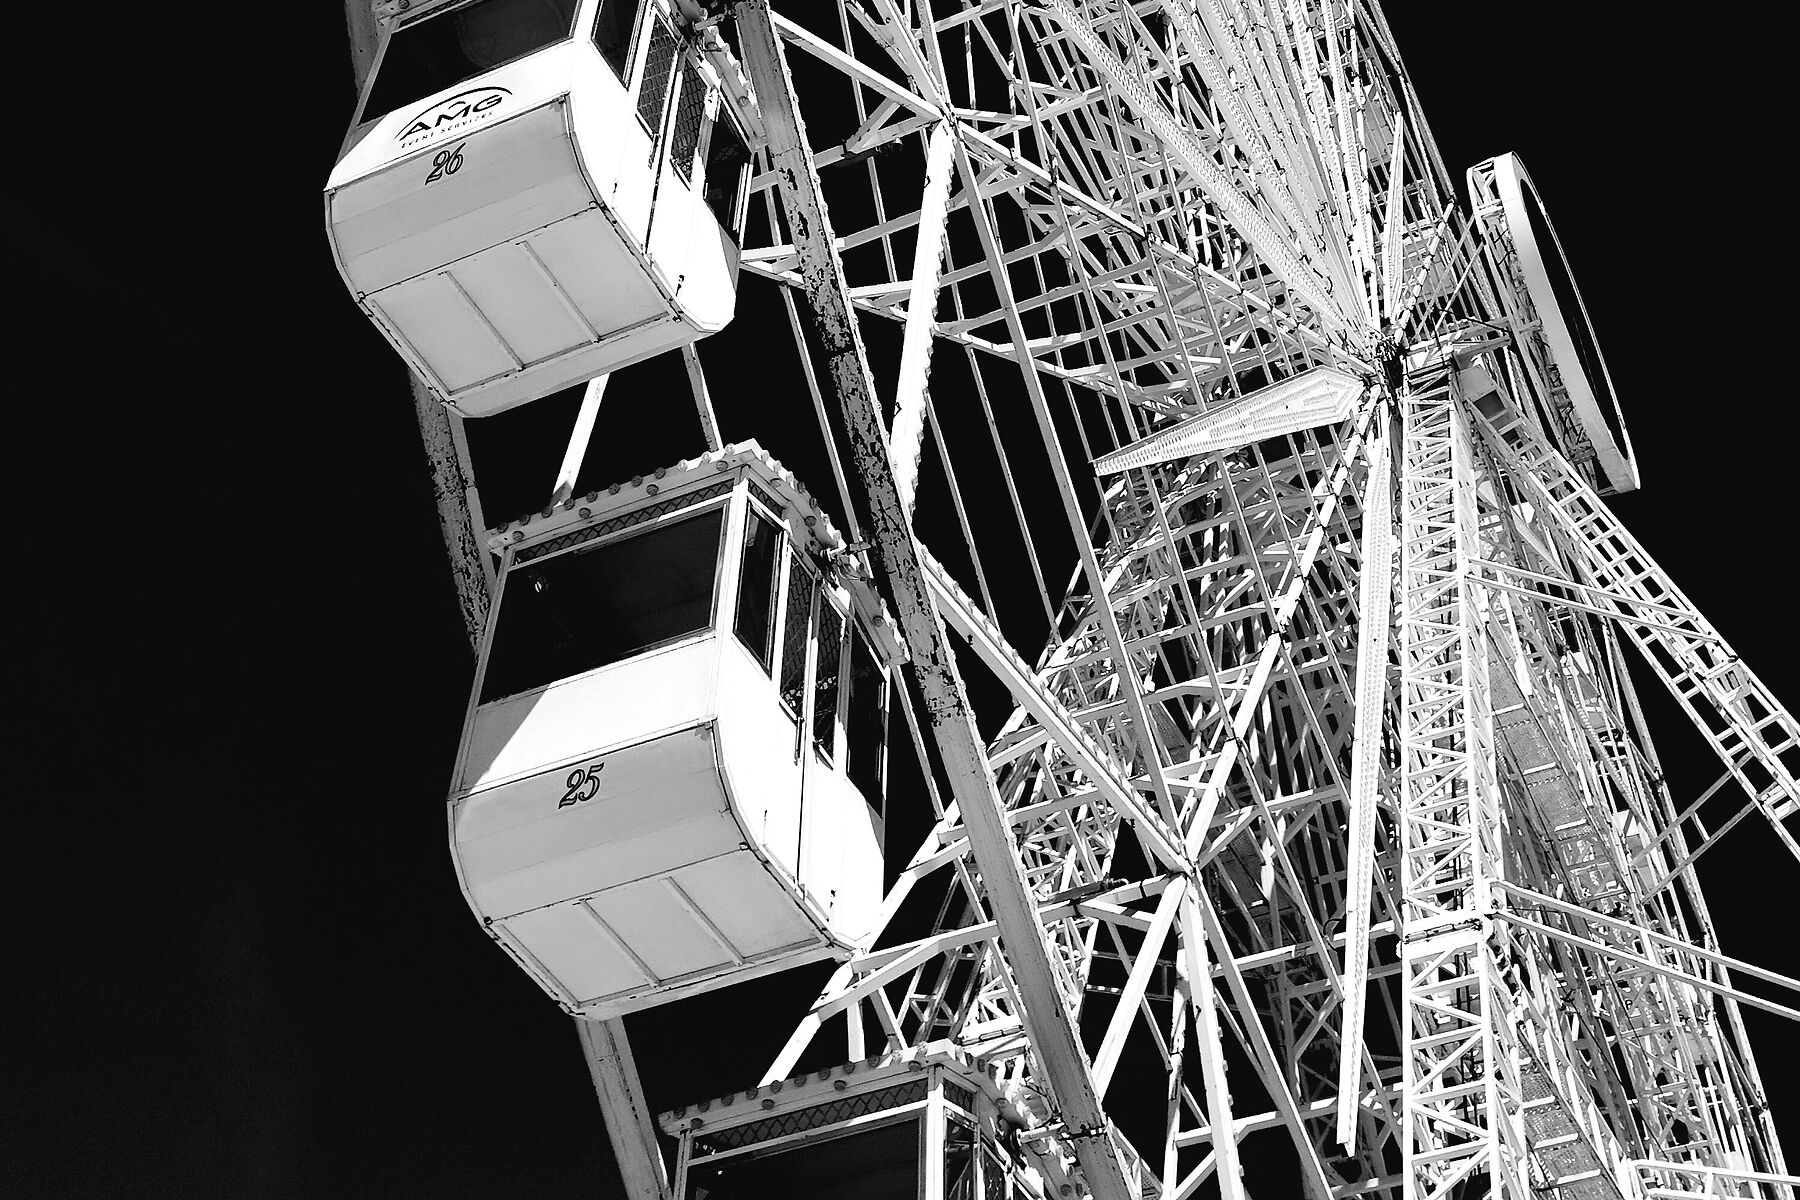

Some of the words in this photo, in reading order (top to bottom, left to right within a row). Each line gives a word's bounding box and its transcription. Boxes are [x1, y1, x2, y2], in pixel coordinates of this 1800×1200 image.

[399, 94, 503, 142] AMG
[401, 132, 434, 149] EVENT
[440, 111, 494, 134] SERVICES
[424, 142, 467, 186] 26
[558, 762, 605, 810] 25
